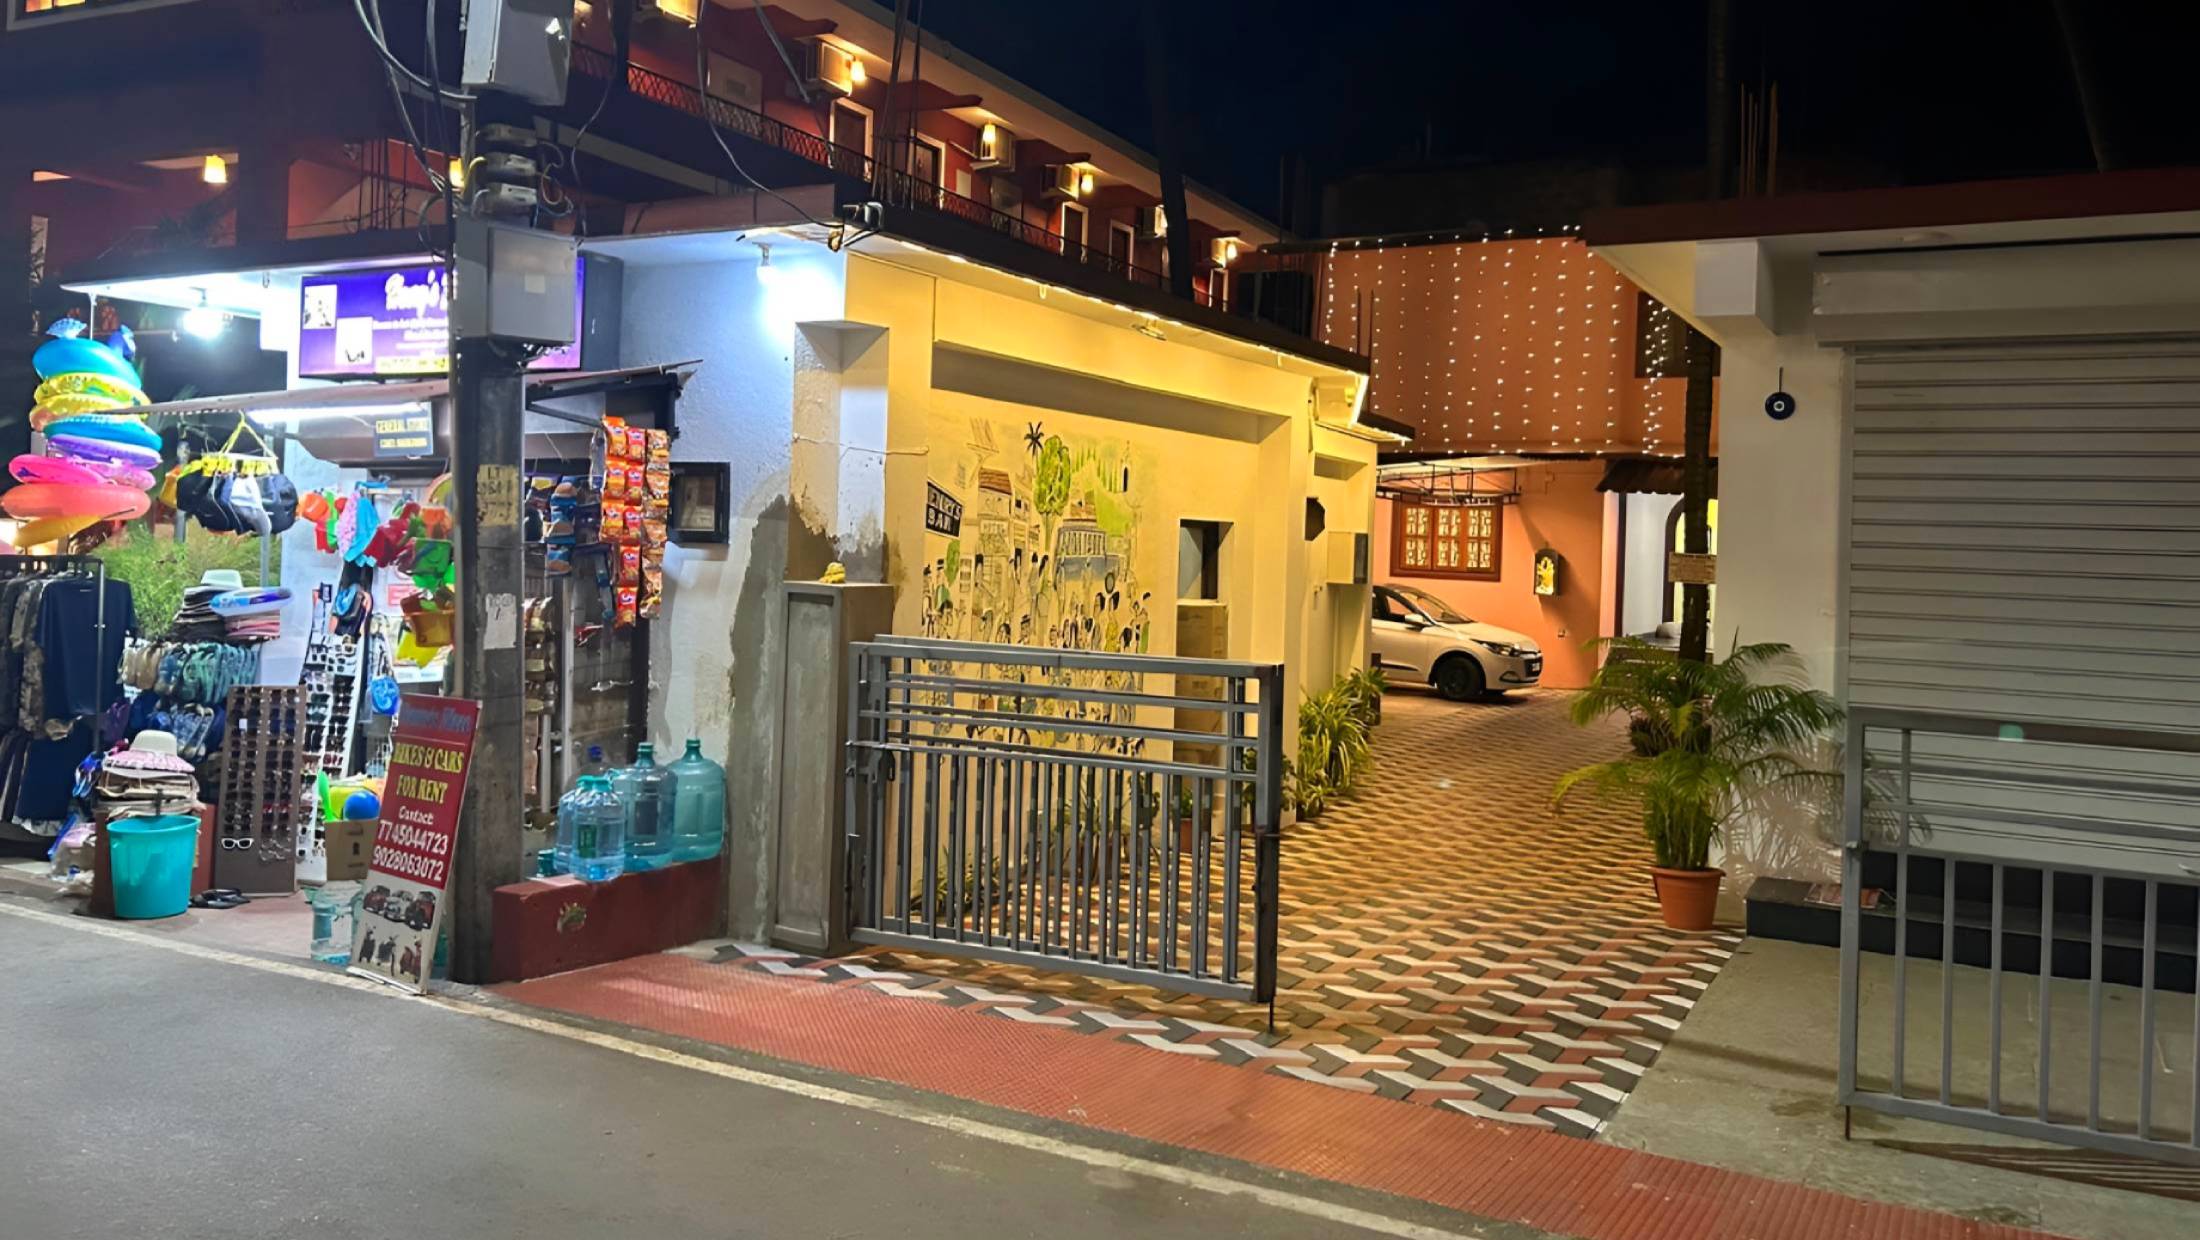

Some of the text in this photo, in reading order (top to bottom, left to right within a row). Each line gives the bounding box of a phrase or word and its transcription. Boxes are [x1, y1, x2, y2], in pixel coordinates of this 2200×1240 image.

[392, 742, 424, 767] BIKES
[434, 749, 464, 773] CARS
[396, 774, 448, 804] FOR RENT
